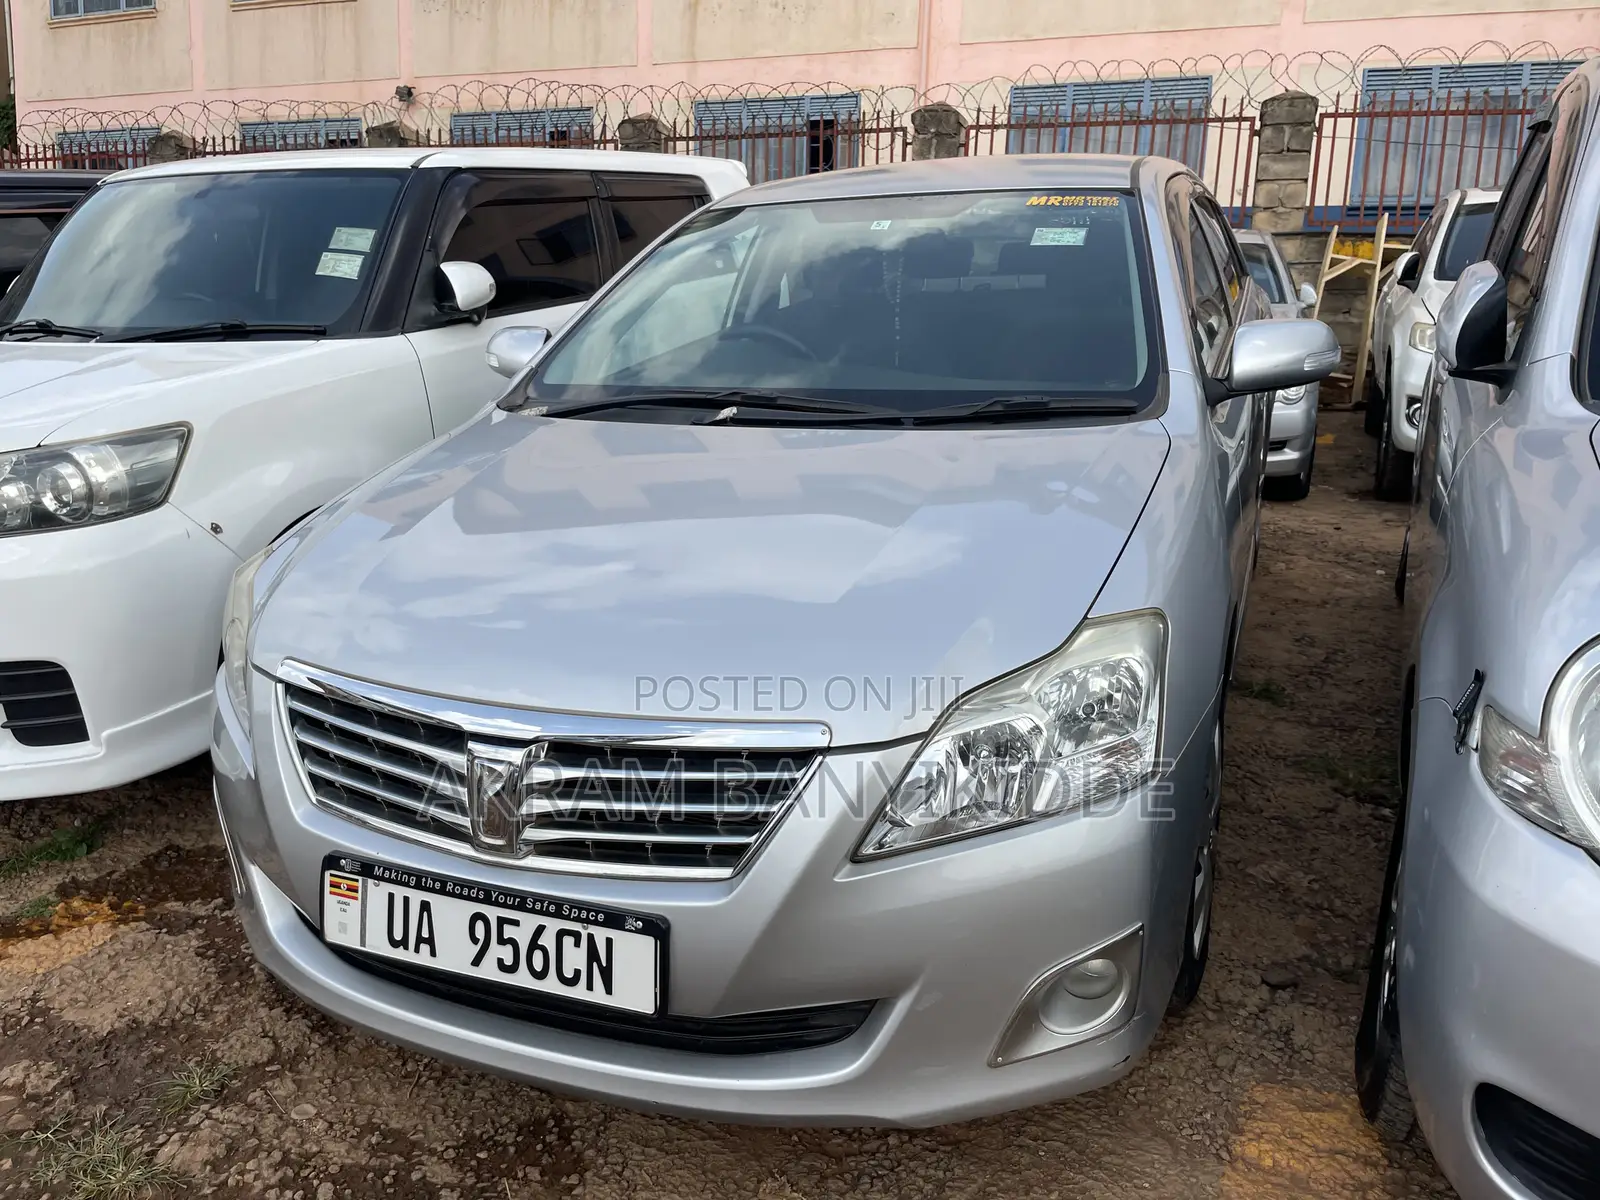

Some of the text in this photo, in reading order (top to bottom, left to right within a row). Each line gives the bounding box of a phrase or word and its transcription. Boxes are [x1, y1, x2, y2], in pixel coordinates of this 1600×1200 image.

[1026, 195, 1062, 206] MR
[373, 865, 416, 887] Making
[421, 877, 441, 890] the
[446, 883, 485, 899] Roads
[491, 890, 521, 906] Your
[525, 898, 556, 913] Safe
[562, 904, 605, 922] Space
[387, 891, 614, 996] UA 956CN
